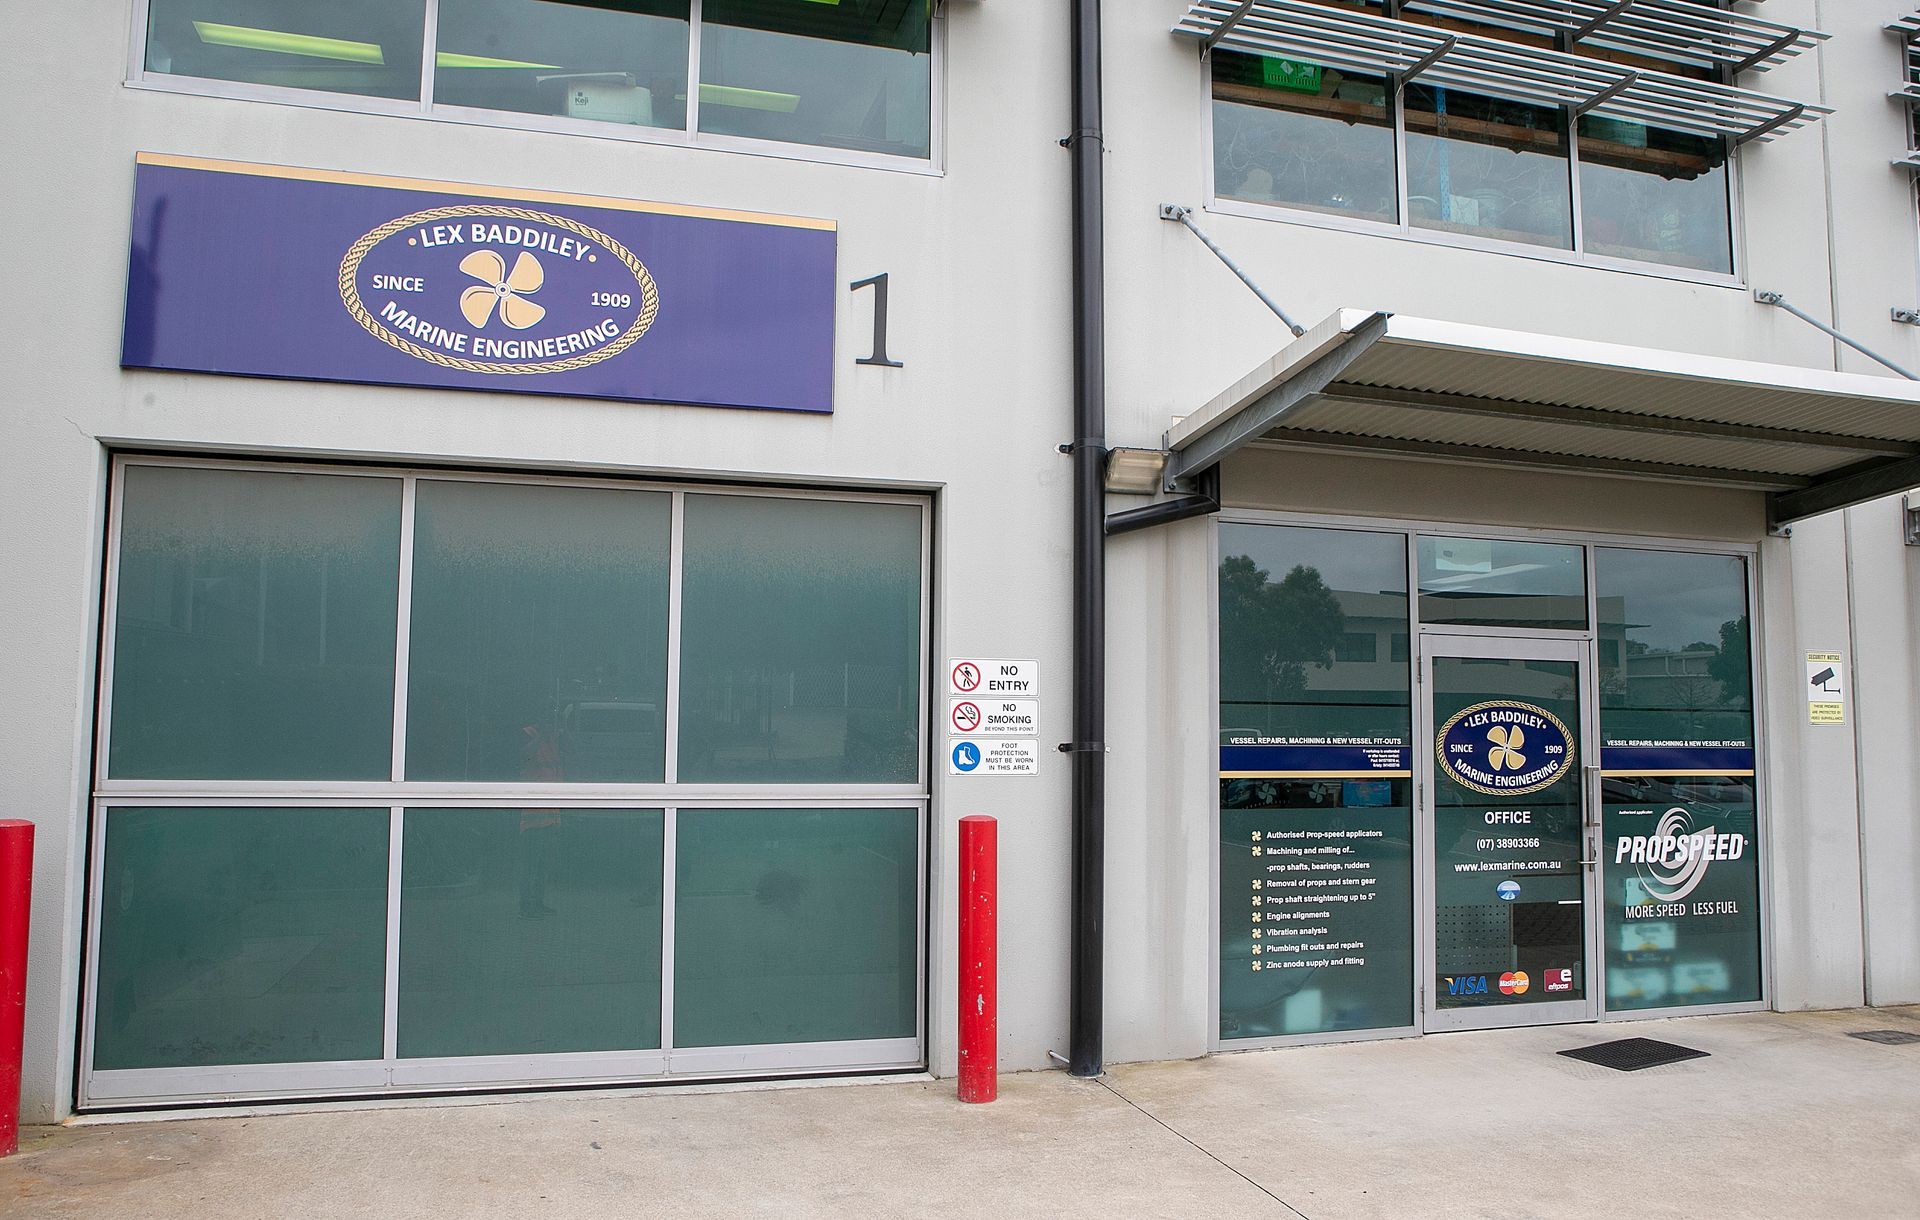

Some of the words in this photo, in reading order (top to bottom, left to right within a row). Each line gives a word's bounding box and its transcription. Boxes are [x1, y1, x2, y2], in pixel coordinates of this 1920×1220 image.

[420, 224, 464, 248] LEX
[471, 223, 590, 262] BADDILEY
[372, 274, 424, 292] SINCE
[591, 292, 631, 308] 1909
[850, 272, 903, 368] 1
[380, 300, 468, 353] MARINE
[472, 318, 620, 359] ENGINEERING
[1000, 666, 1018, 676] NO
[989, 680, 1029, 690] ENTRY
[988, 716, 1032, 724] SMOKING
[1468, 712, 1489, 728] LEX
[1491, 711, 1543, 729] BADDILEY
[1450, 744, 1473, 753] SINCE
[1545, 745, 1562, 754] 1909
[1454, 758, 1493, 785] MARINE
[1495, 760, 1558, 787] ENGINEERING
[1485, 811, 1531, 824] OFFICE
[1266, 831, 1304, 839] Authorised
[1346, 830, 1383, 838] applicators
[1476, 839, 1494, 851] (07)
[1496, 838, 1540, 848] 38903366
[1615, 833, 1744, 864] PROPSPEED
[1266, 847, 1302, 856] Machining
[1318, 847, 1341, 855] milling
[1287, 863, 1310, 871] shafts,
[1312, 862, 1342, 870] bearings,
[1454, 861, 1561, 872] www.lexmarine.com.au
[1307, 880, 1327, 888] props
[1285, 895, 1303, 903] shaft
[1304, 894, 1348, 903] straightening
[1350, 894, 1358, 902] up
[1267, 912, 1291, 921] Engine
[1292, 911, 1330, 920] alignments
[1626, 905, 1654, 919] MORE
[1656, 904, 1686, 917] SPEED
[1693, 902, 1714, 915] LESS
[1716, 901, 1738, 914] FUEL
[1266, 928, 1298, 936] Vibration
[1299, 927, 1328, 936] analysis
[1266, 944, 1300, 953] Plumbing
[1326, 942, 1339, 950] and
[1340, 941, 1364, 950] repairs
[1266, 961, 1282, 969] Zinc
[1283, 960, 1304, 968] anode
[1306, 959, 1329, 967] supply
[1345, 957, 1364, 965] fitting
[1561, 969, 1571, 981] e
[1445, 976, 1488, 995] VISA
[1499, 979, 1529, 987] MasterCard
